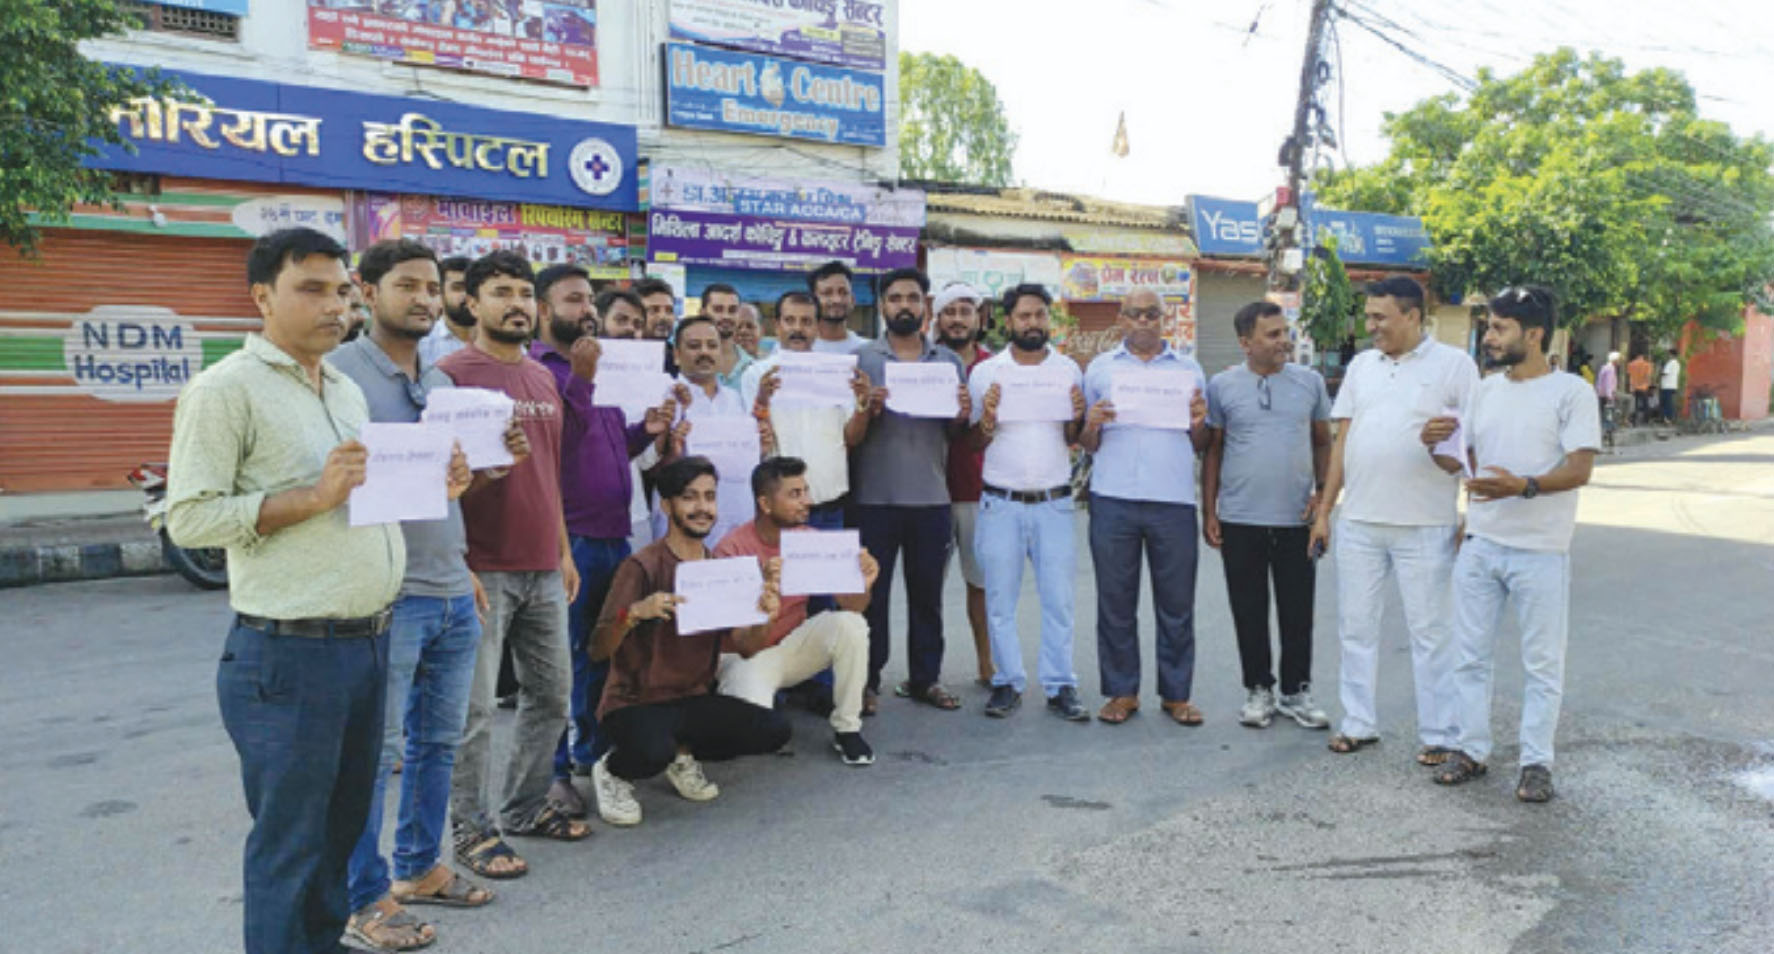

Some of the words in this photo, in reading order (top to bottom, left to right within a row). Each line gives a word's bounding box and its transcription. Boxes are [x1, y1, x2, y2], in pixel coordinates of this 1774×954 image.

[672, 48, 757, 96] Heart
[792, 66, 880, 112] Centre
[722, 98, 839, 141] Emergency
[740, 200, 784, 215] STAR
[1201, 208, 1262, 244] Yas
[83, 322, 183, 350] NDM
[74, 354, 189, 390] Hospital
